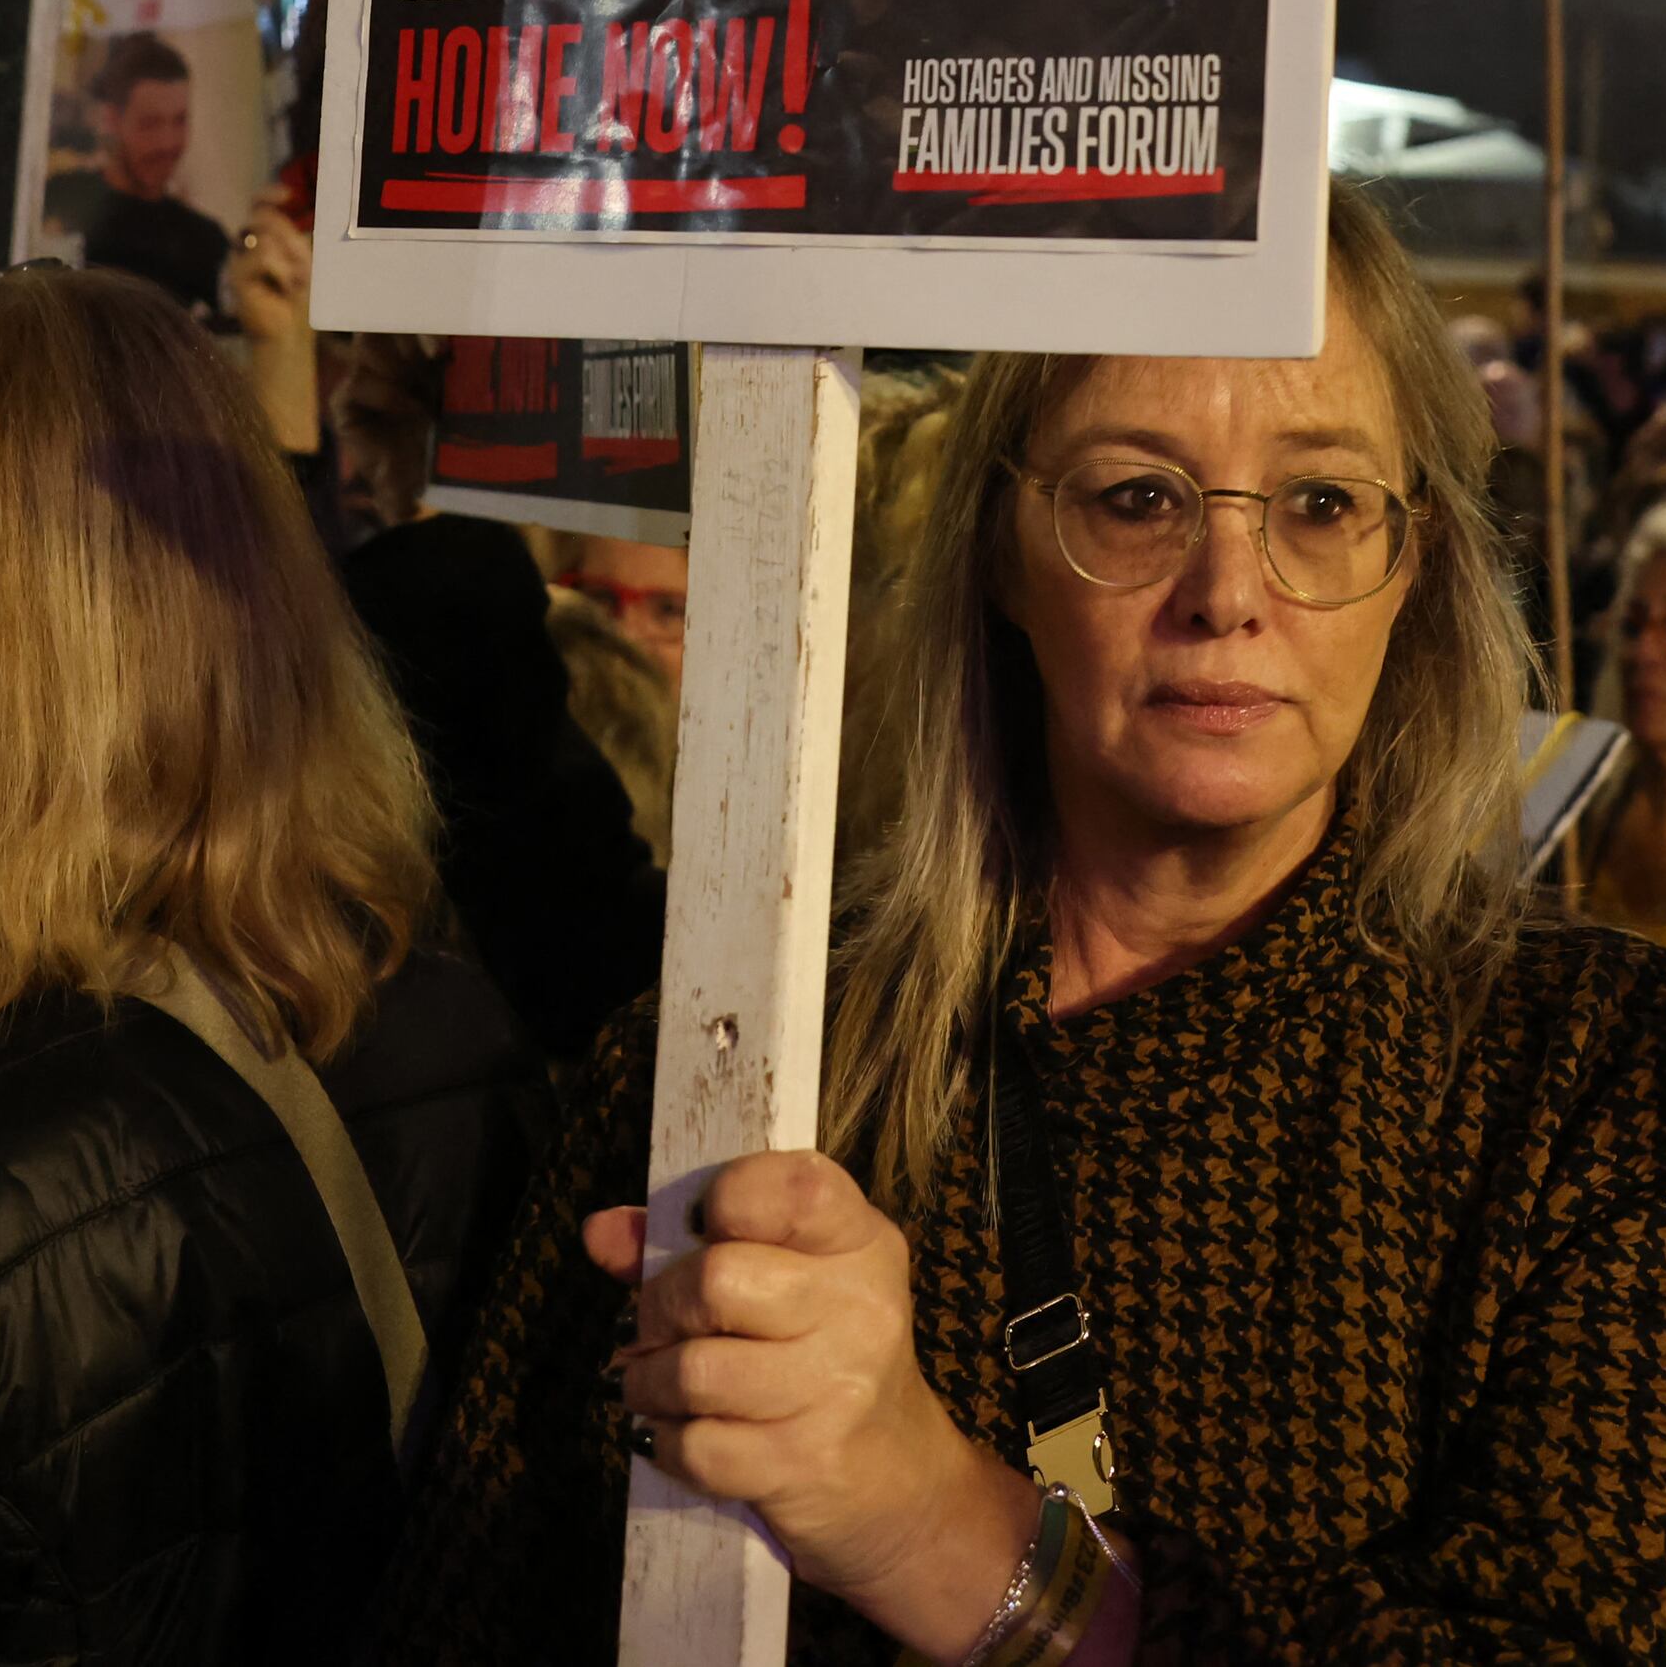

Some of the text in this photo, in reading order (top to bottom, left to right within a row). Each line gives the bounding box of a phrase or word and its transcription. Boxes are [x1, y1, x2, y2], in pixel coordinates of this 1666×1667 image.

[391, 23, 584, 154] HOME
[903, 54, 1221, 104] HOSTAGES AND MISSING
[897, 105, 1220, 176] FAMILIES FORUM
